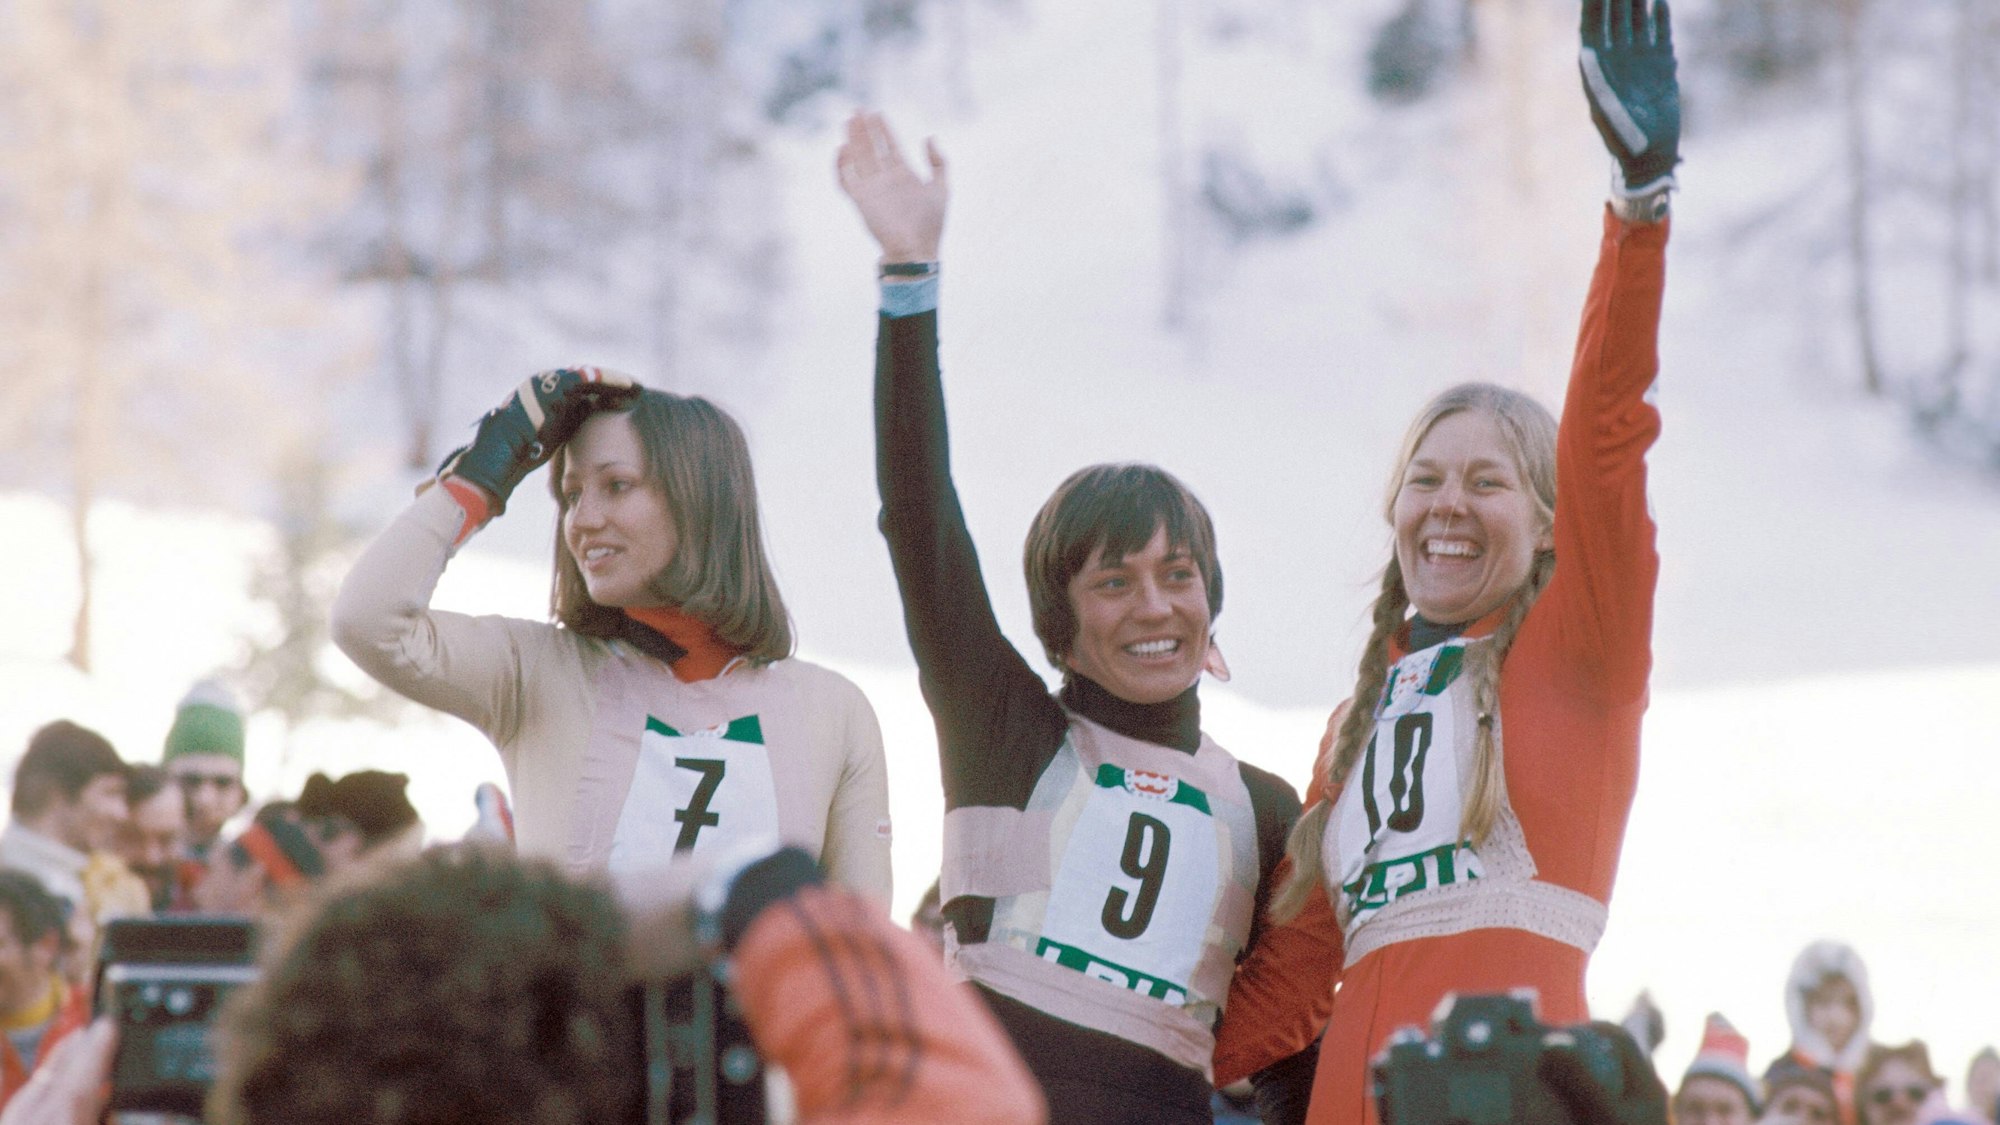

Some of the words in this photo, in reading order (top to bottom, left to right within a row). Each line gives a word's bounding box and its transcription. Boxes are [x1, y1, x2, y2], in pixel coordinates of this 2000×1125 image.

[672, 757, 725, 860] 7
[1362, 712, 1433, 854] 10
[1101, 811, 1171, 940] 9
